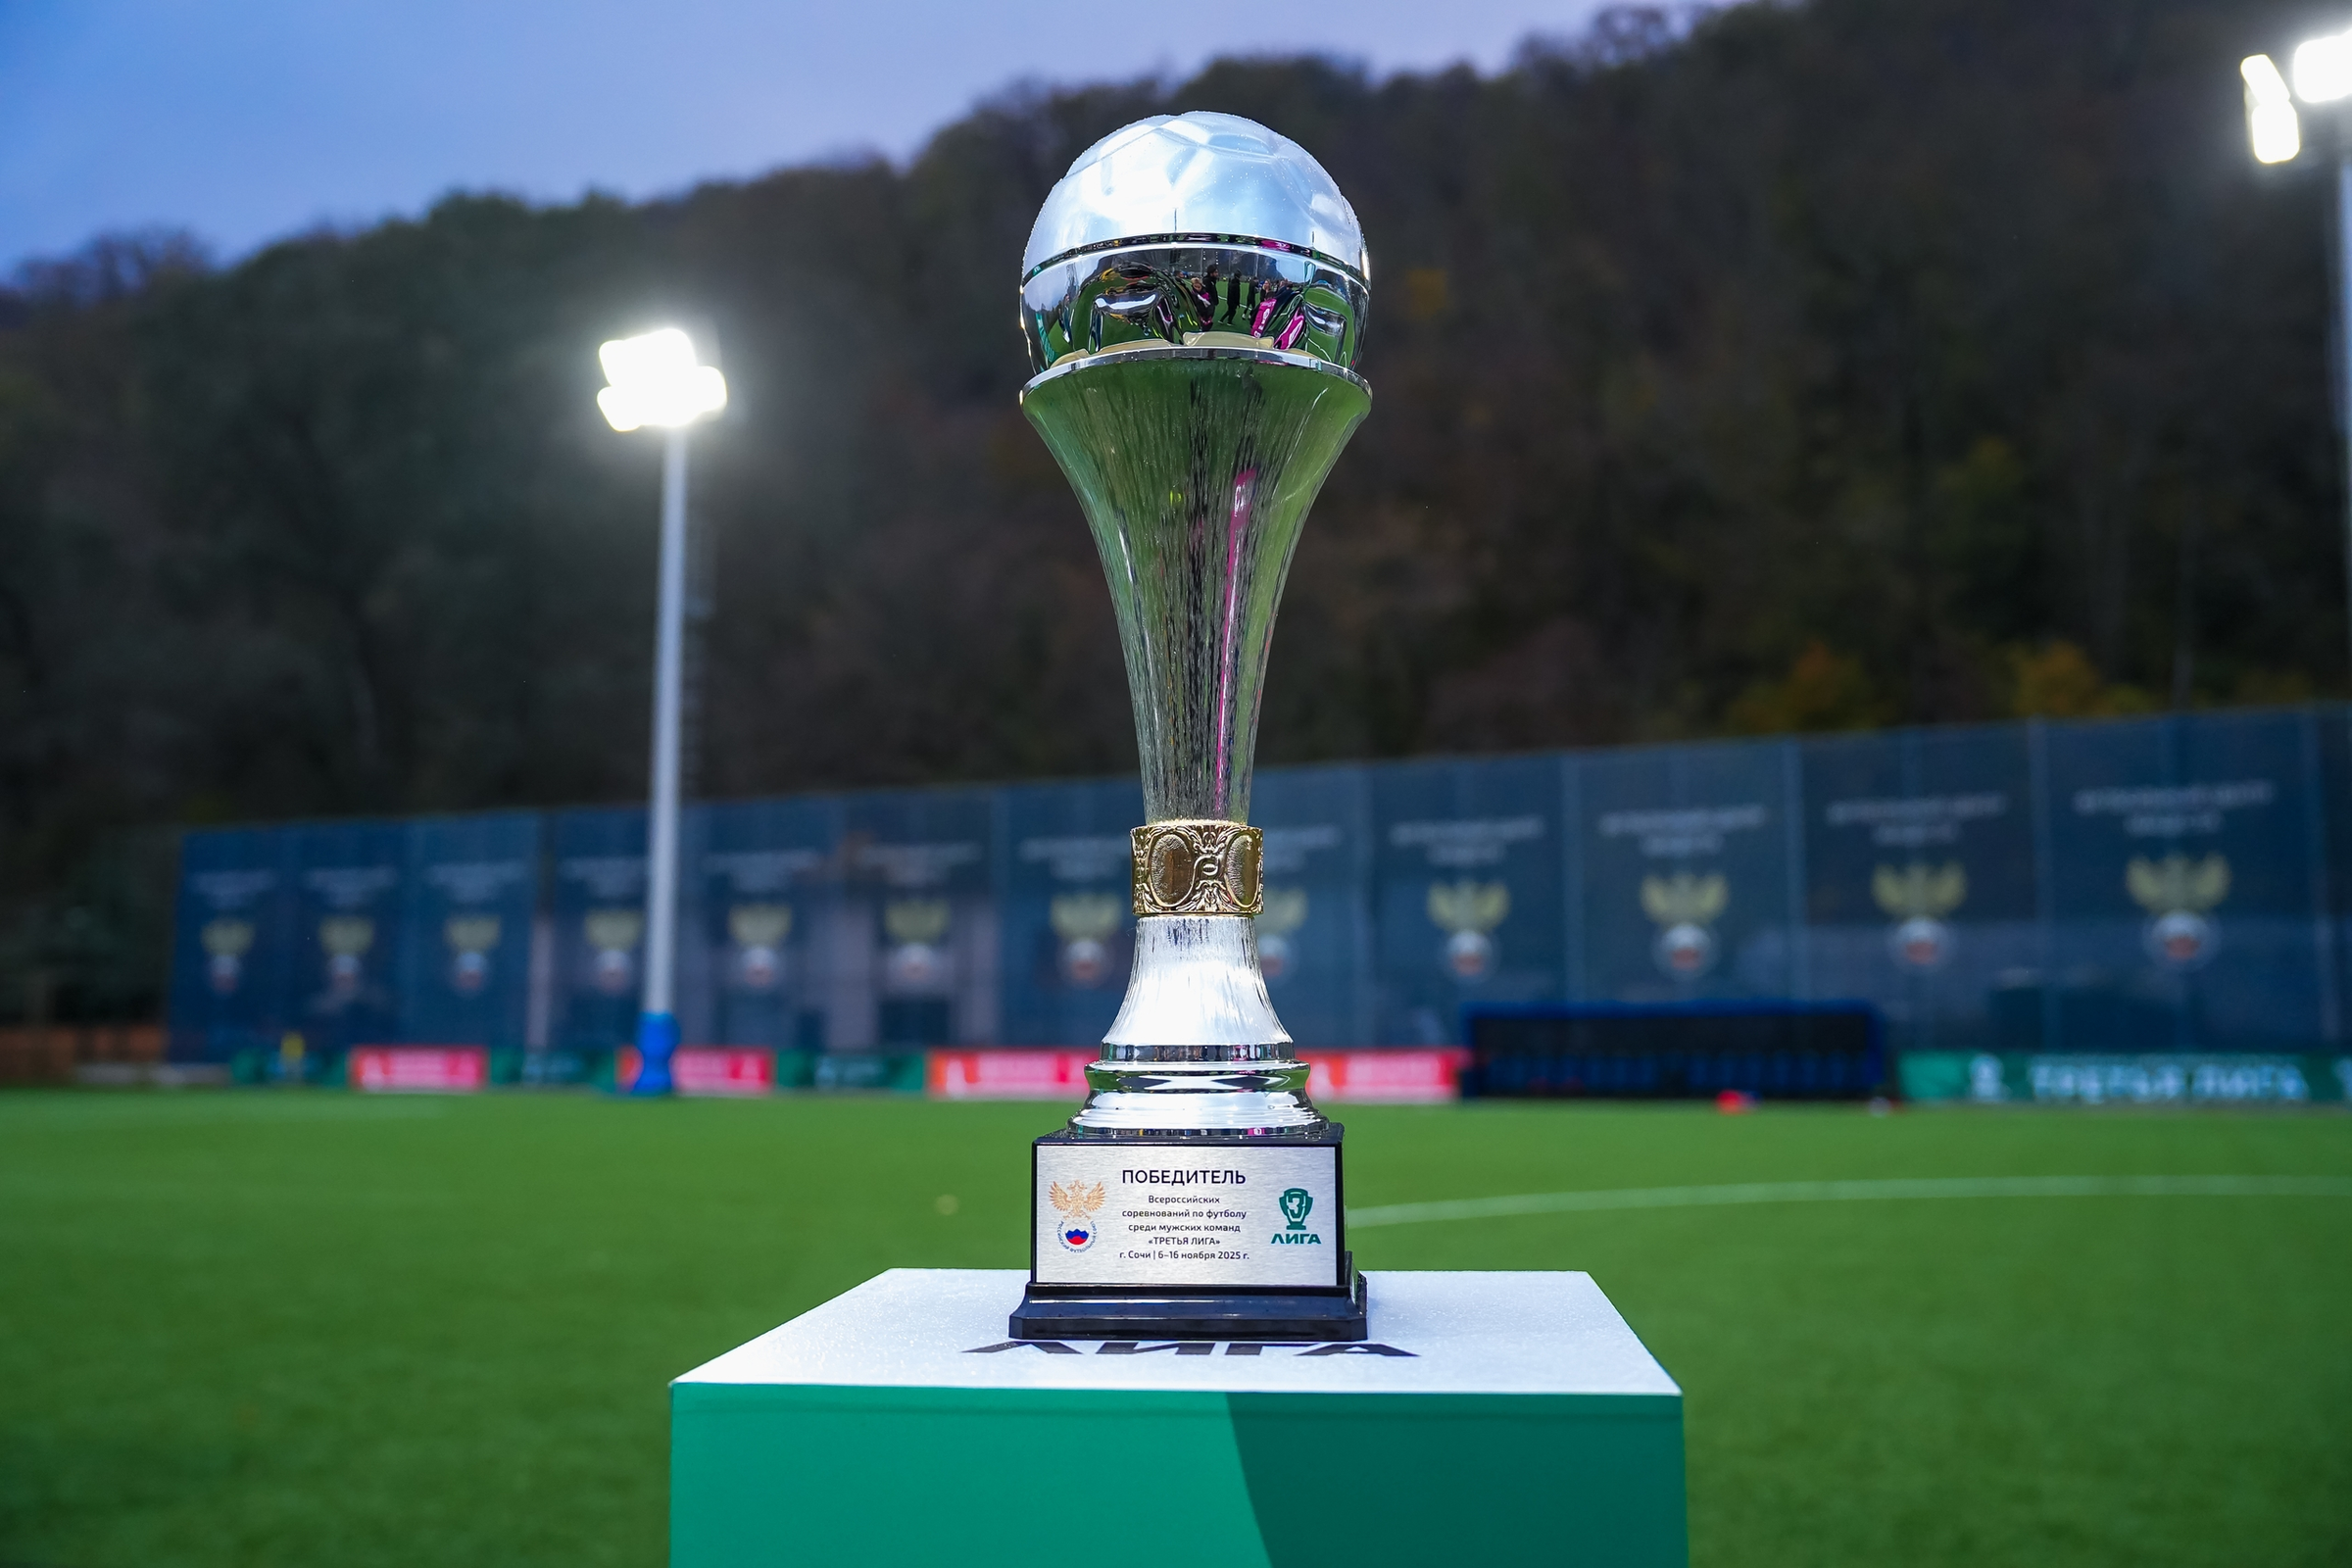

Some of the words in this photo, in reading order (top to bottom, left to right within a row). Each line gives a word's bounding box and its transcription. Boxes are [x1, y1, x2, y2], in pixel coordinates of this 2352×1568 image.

[1122, 1169, 1247, 1186] ПОБЕДИТЕЛЬ
[1148, 1195, 1220, 1204] Всероссийских
[1121, 1209, 1191, 1218] соревнований
[1205, 1209, 1247, 1219] футболу
[1128, 1224, 1156, 1233] среди
[1158, 1224, 1201, 1233] мужских
[1203, 1224, 1241, 1233] команд
[1148, 1236, 1189, 1246] «ТРЕТЬЯ
[1191, 1237, 1221, 1246] ЛИГА»
[1270, 1233, 1322, 1245] ЛИГА
[1128, 1250, 1152, 1259] Сочи
[1181, 1250, 1216, 1261] ноября
[1217, 1250, 1241, 1260] 2025
